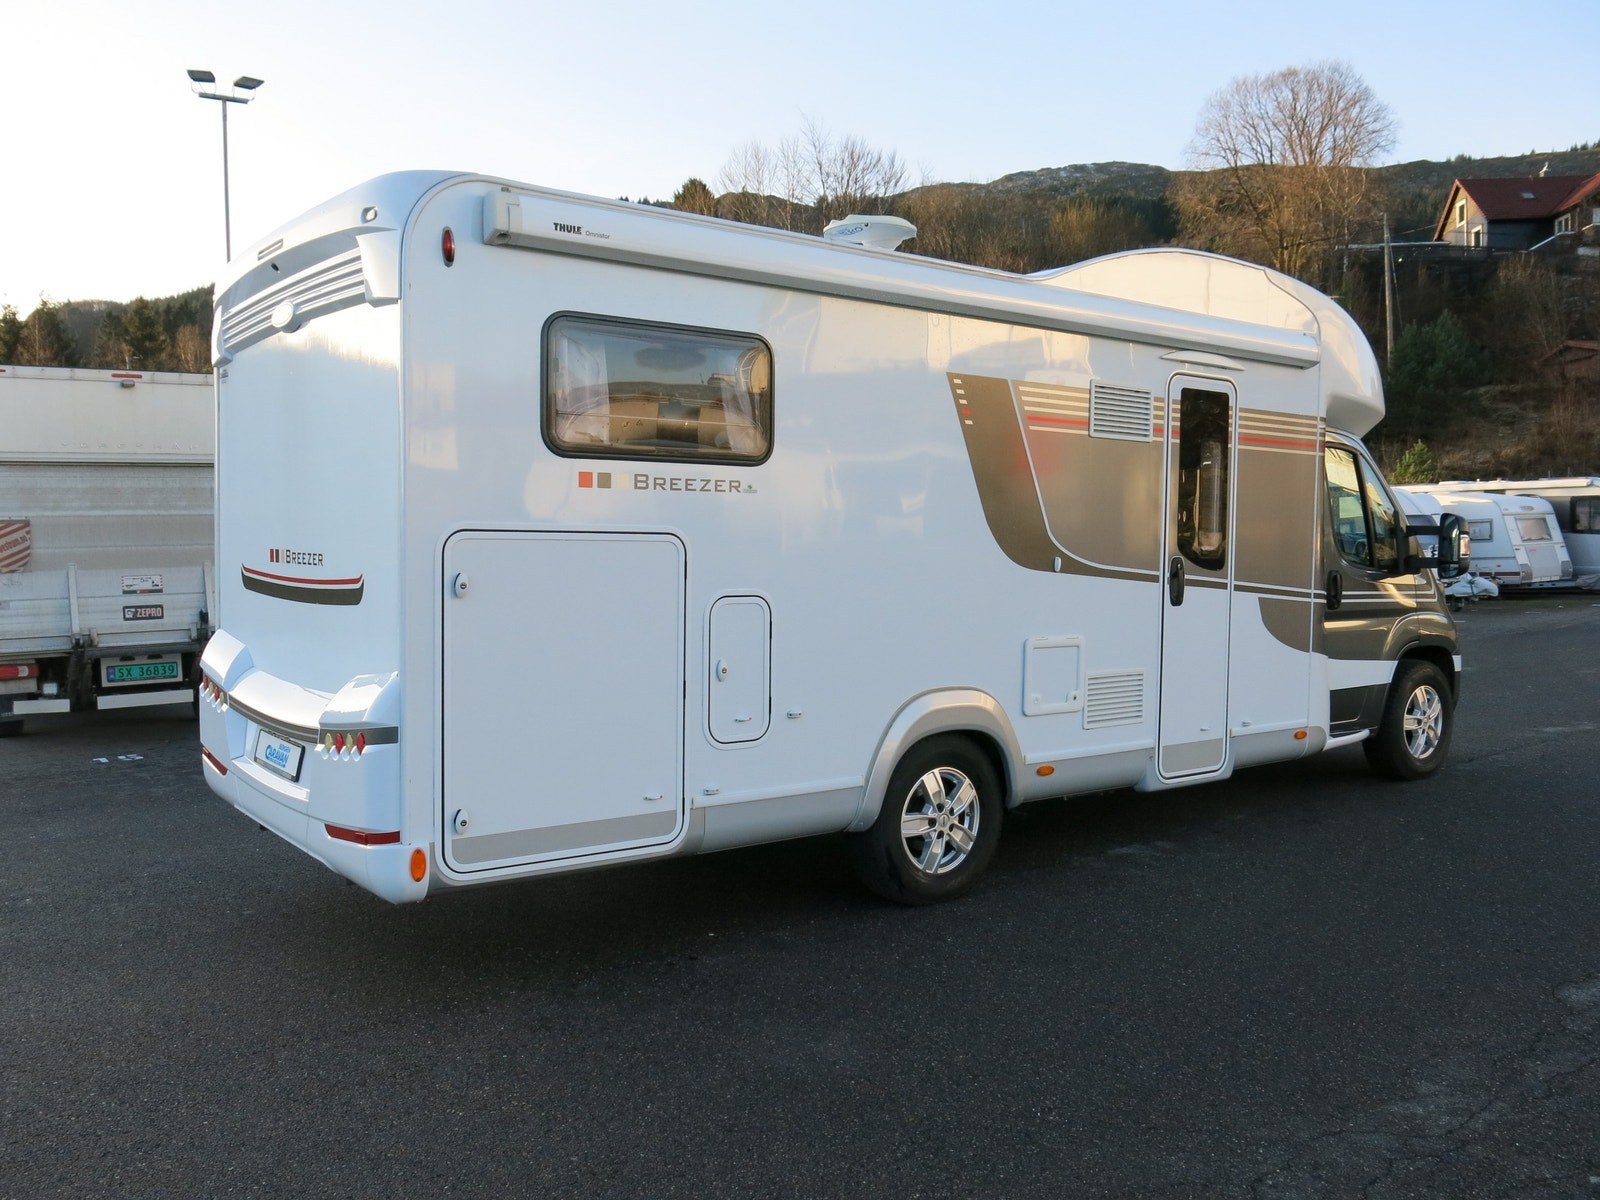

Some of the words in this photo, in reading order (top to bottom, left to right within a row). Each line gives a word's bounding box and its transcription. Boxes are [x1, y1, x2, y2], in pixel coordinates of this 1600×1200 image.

[553, 222, 582, 235] THULE
[585, 230, 610, 239] Omnistor
[634, 474, 742, 493] BREEZER
[286, 549, 323, 567] BREEZER
[136, 607, 162, 618] ZEPRO
[118, 667, 132, 678] SX
[139, 664, 175, 677] 36839
